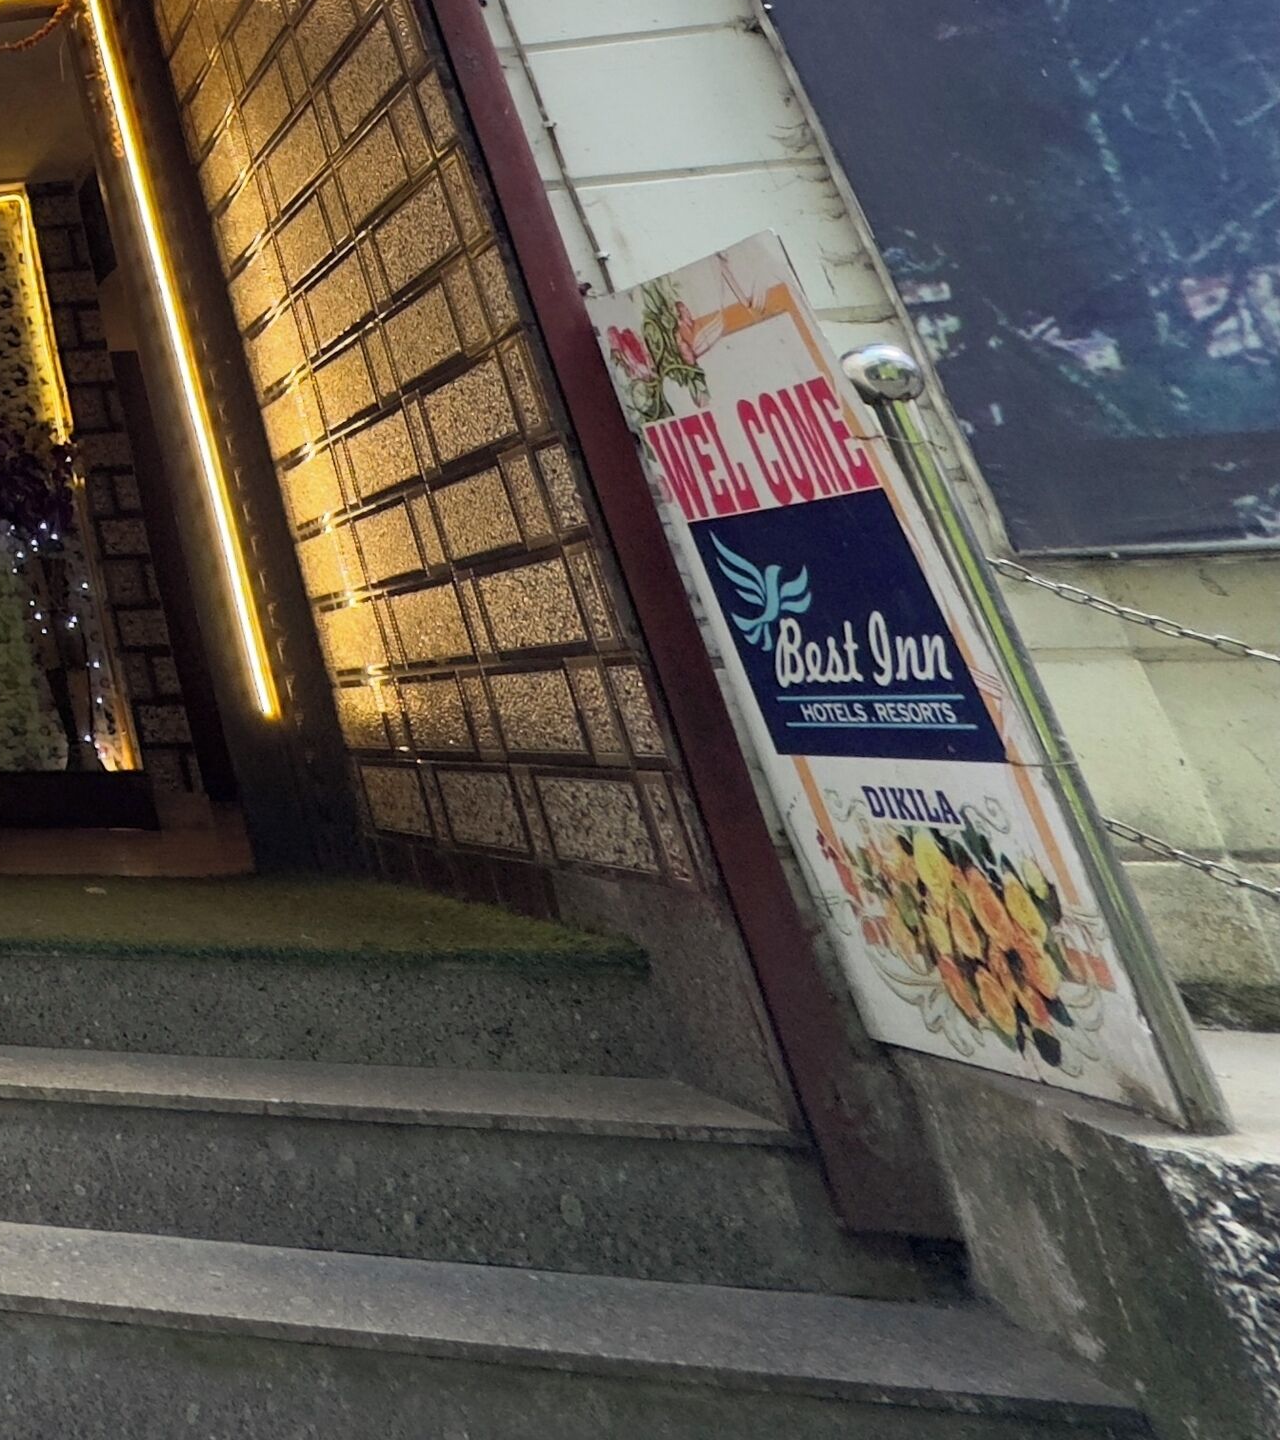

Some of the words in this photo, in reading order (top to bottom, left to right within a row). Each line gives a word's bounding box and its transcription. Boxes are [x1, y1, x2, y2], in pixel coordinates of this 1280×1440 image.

[775, 617, 864, 688] Best
[868, 610, 954, 687] Inn
[800, 703, 868, 723] HOTELS
[873, 702, 958, 724] RESORTS
[861, 785, 962, 825] DIKILA
